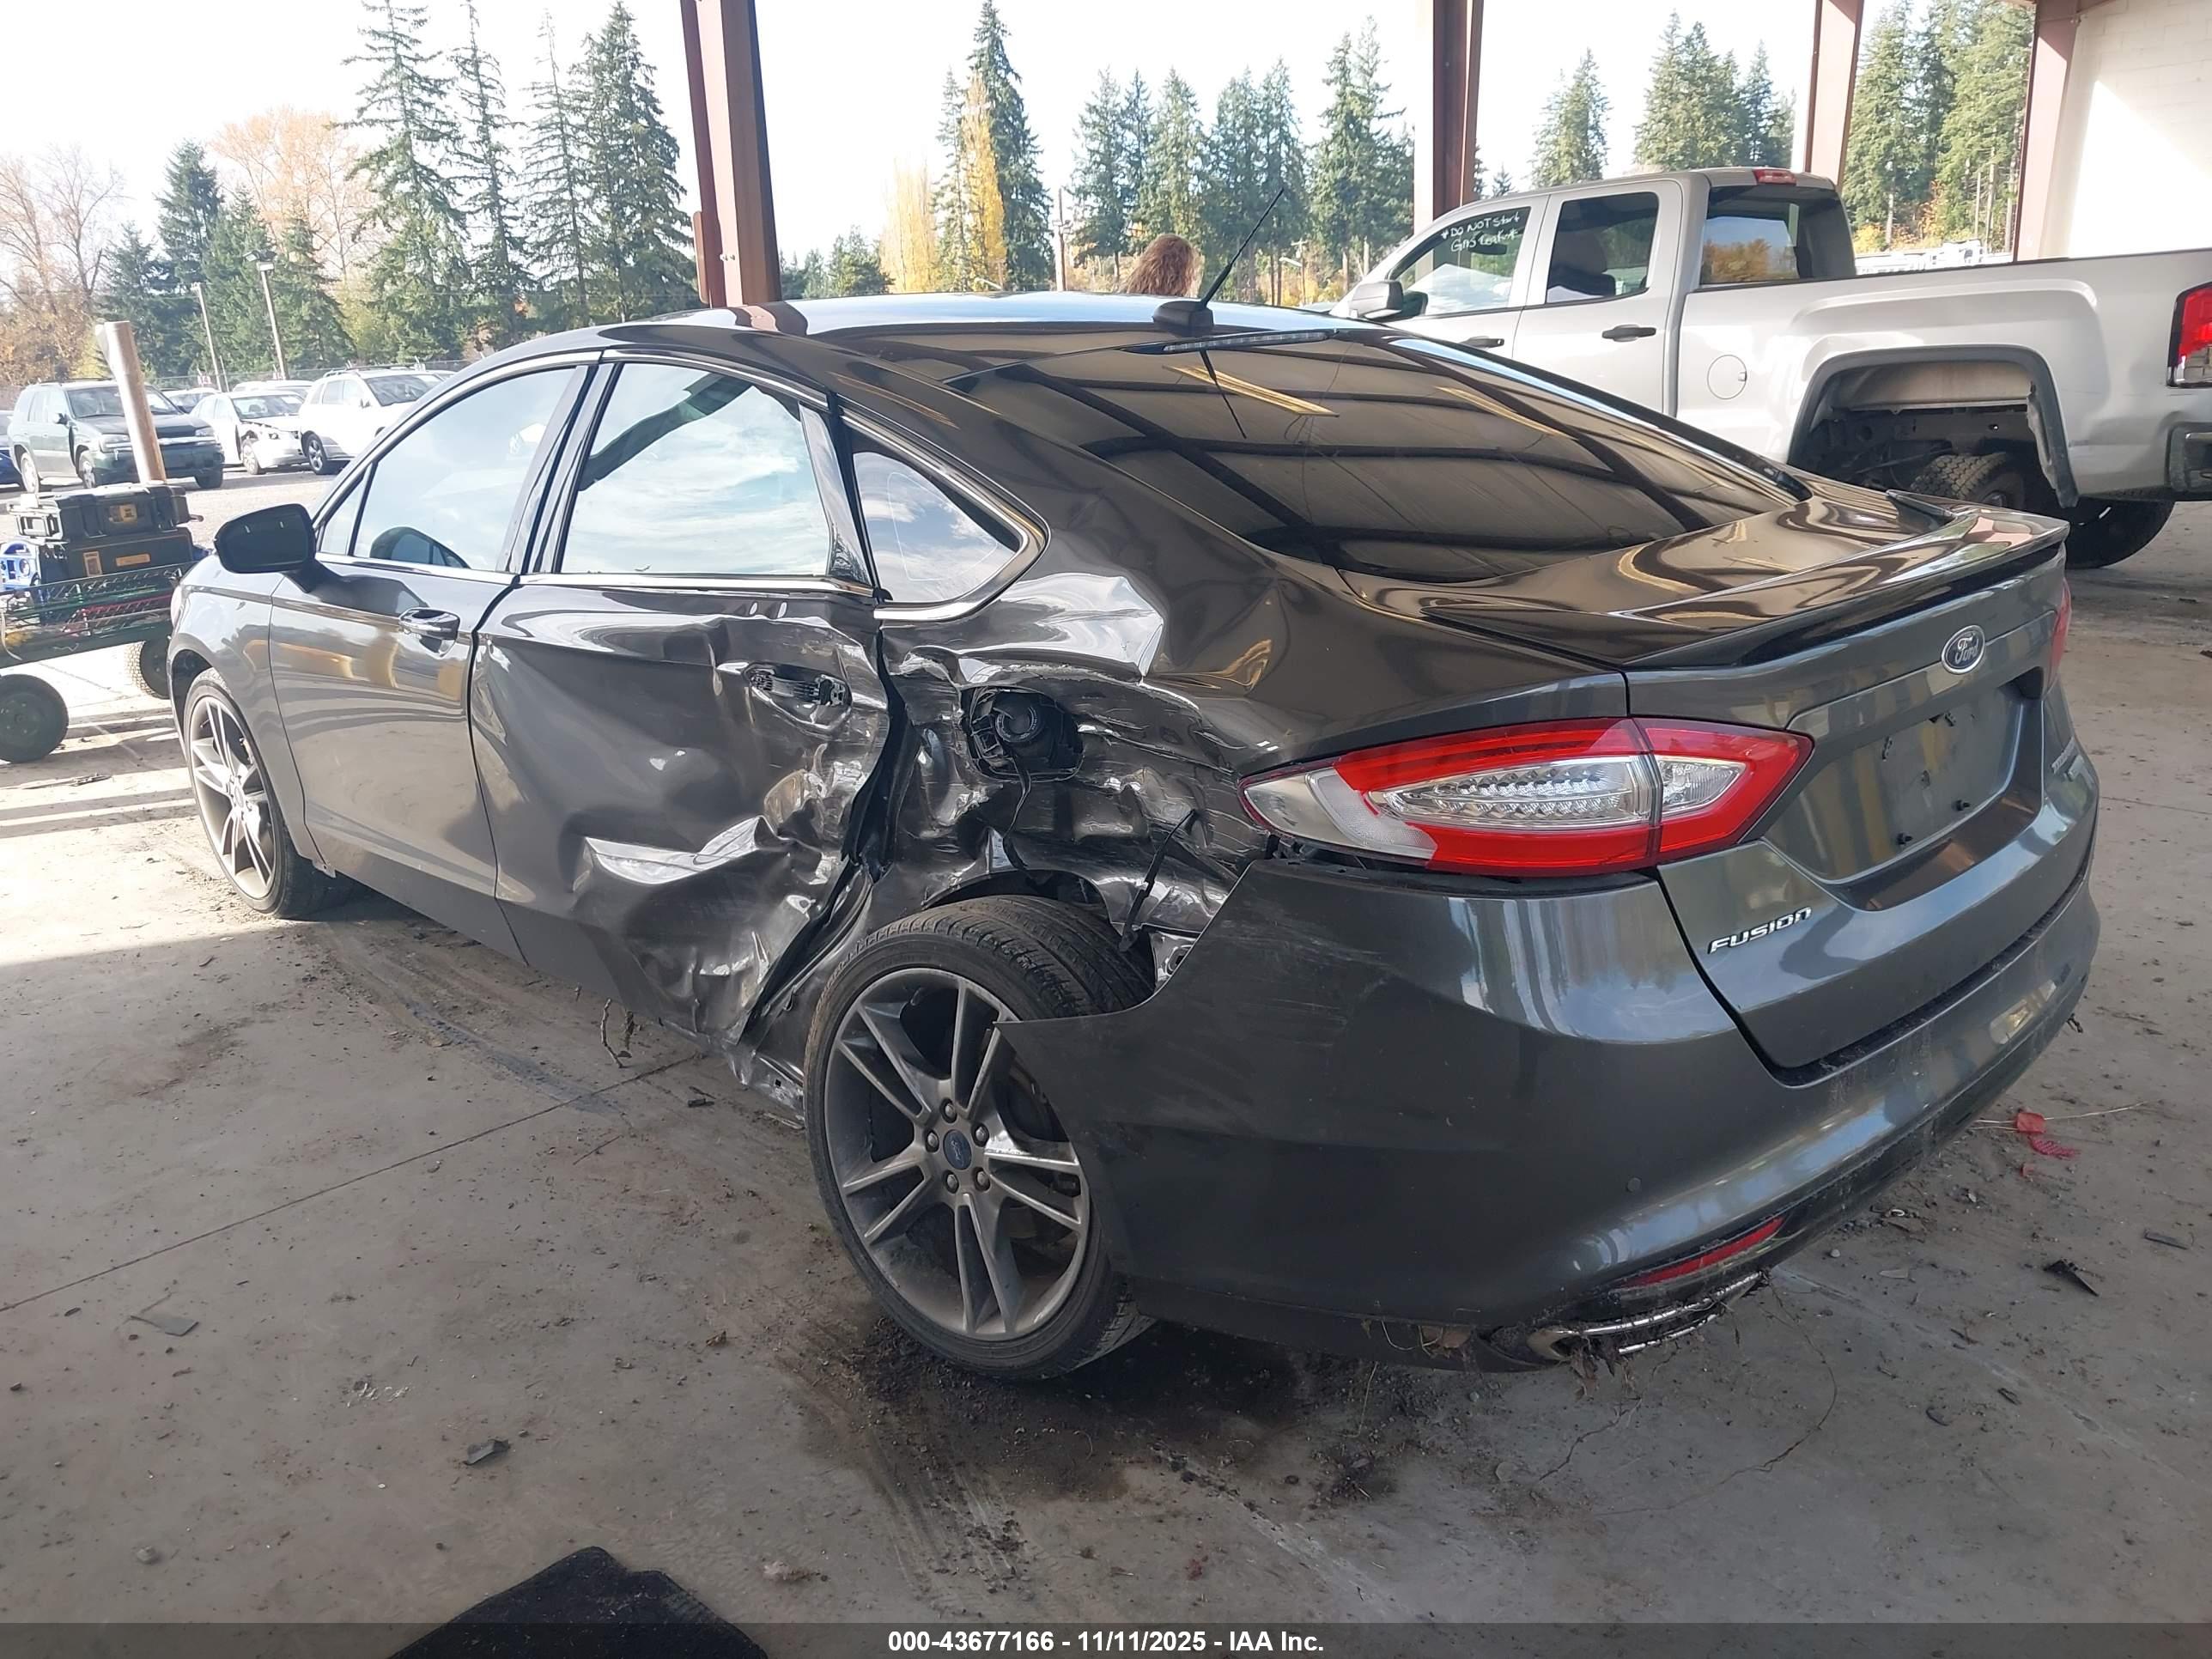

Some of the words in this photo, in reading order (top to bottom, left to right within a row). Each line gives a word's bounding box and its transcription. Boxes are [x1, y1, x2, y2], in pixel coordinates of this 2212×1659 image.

[1450, 226, 1464, 237] DO
[1467, 217, 1492, 233] NOT
[1954, 633, 1979, 664] Ford
[1708, 906, 1812, 955] FUSION
